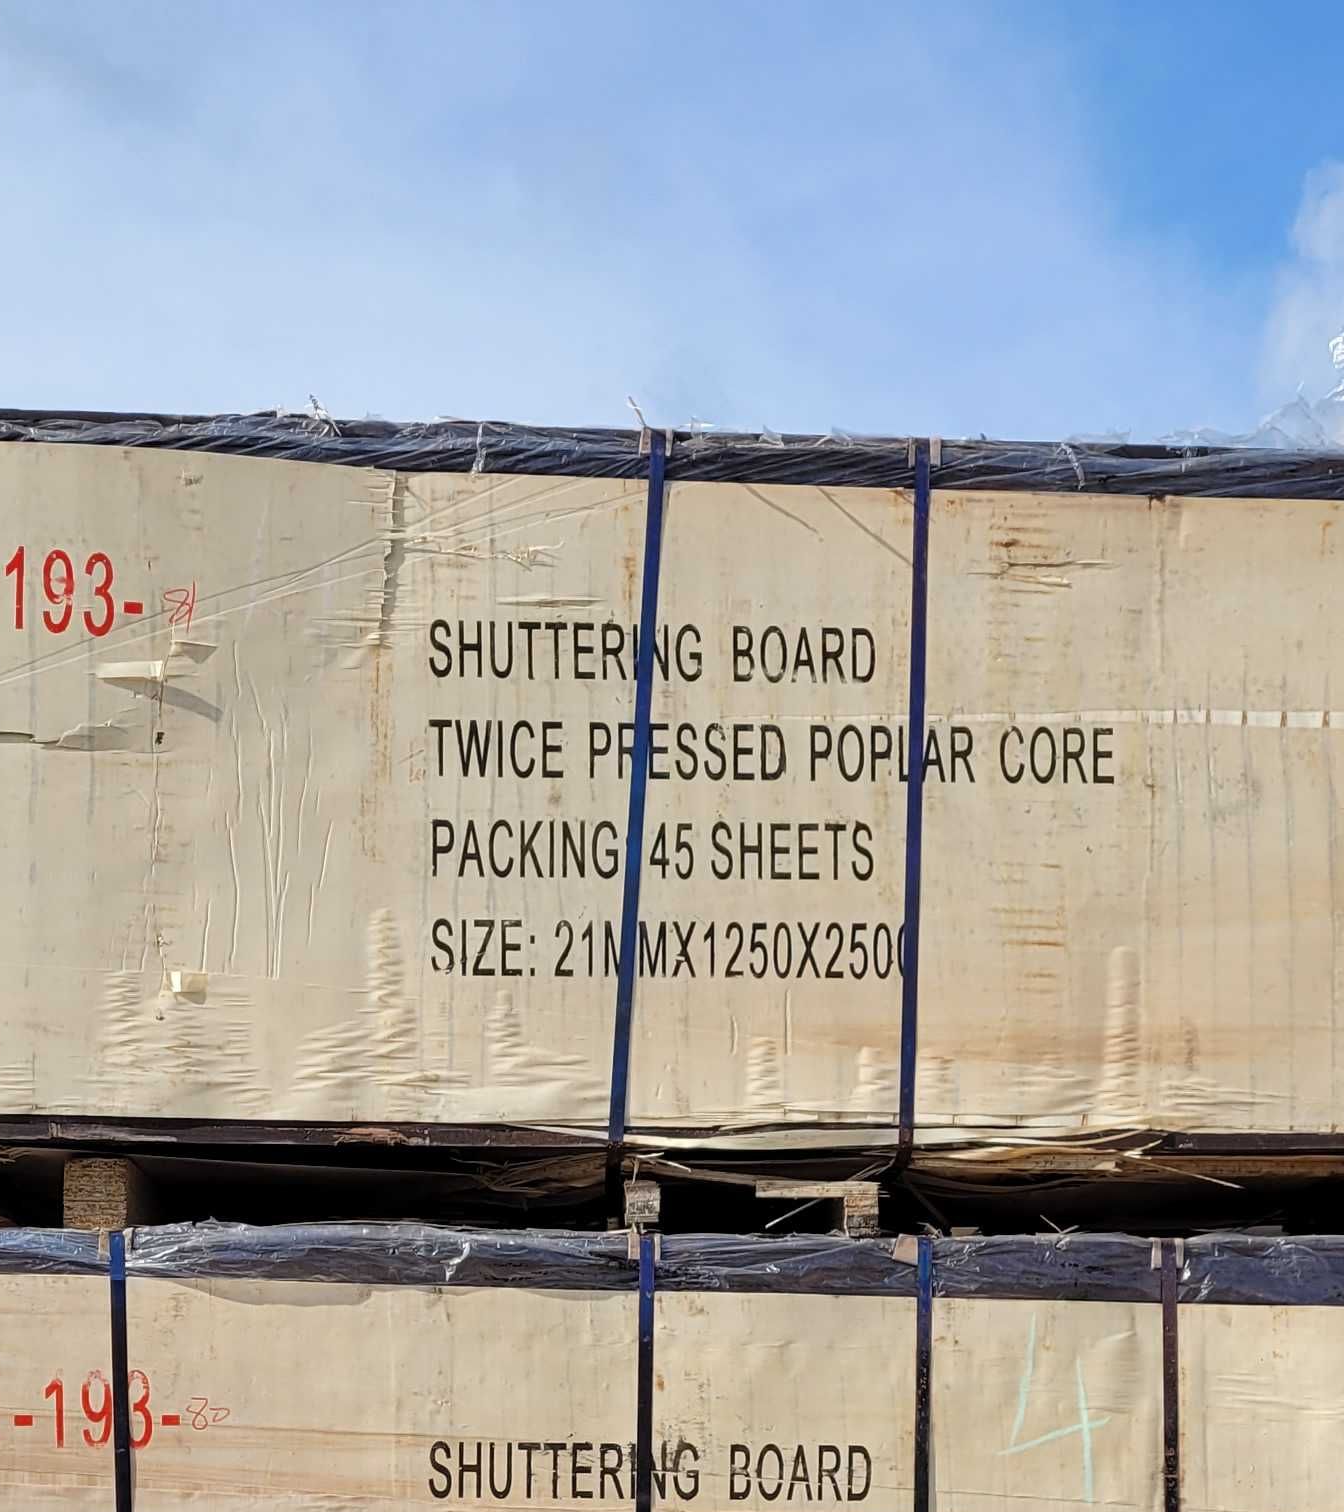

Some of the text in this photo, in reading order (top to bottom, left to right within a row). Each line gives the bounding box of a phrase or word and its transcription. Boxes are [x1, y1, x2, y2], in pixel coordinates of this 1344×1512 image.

[732, 624, 876, 685] BOARD
[428, 718, 565, 779] TWICE
[809, 723, 976, 784] POPLAR
[998, 725, 1116, 785] CORE
[649, 821, 695, 880] 45
[710, 820, 875, 881] SHEETS
[431, 918, 537, 977] SIZE:
[992, 1311, 1113, 1504] 4
[729, 1442, 873, 1502] BOARD
